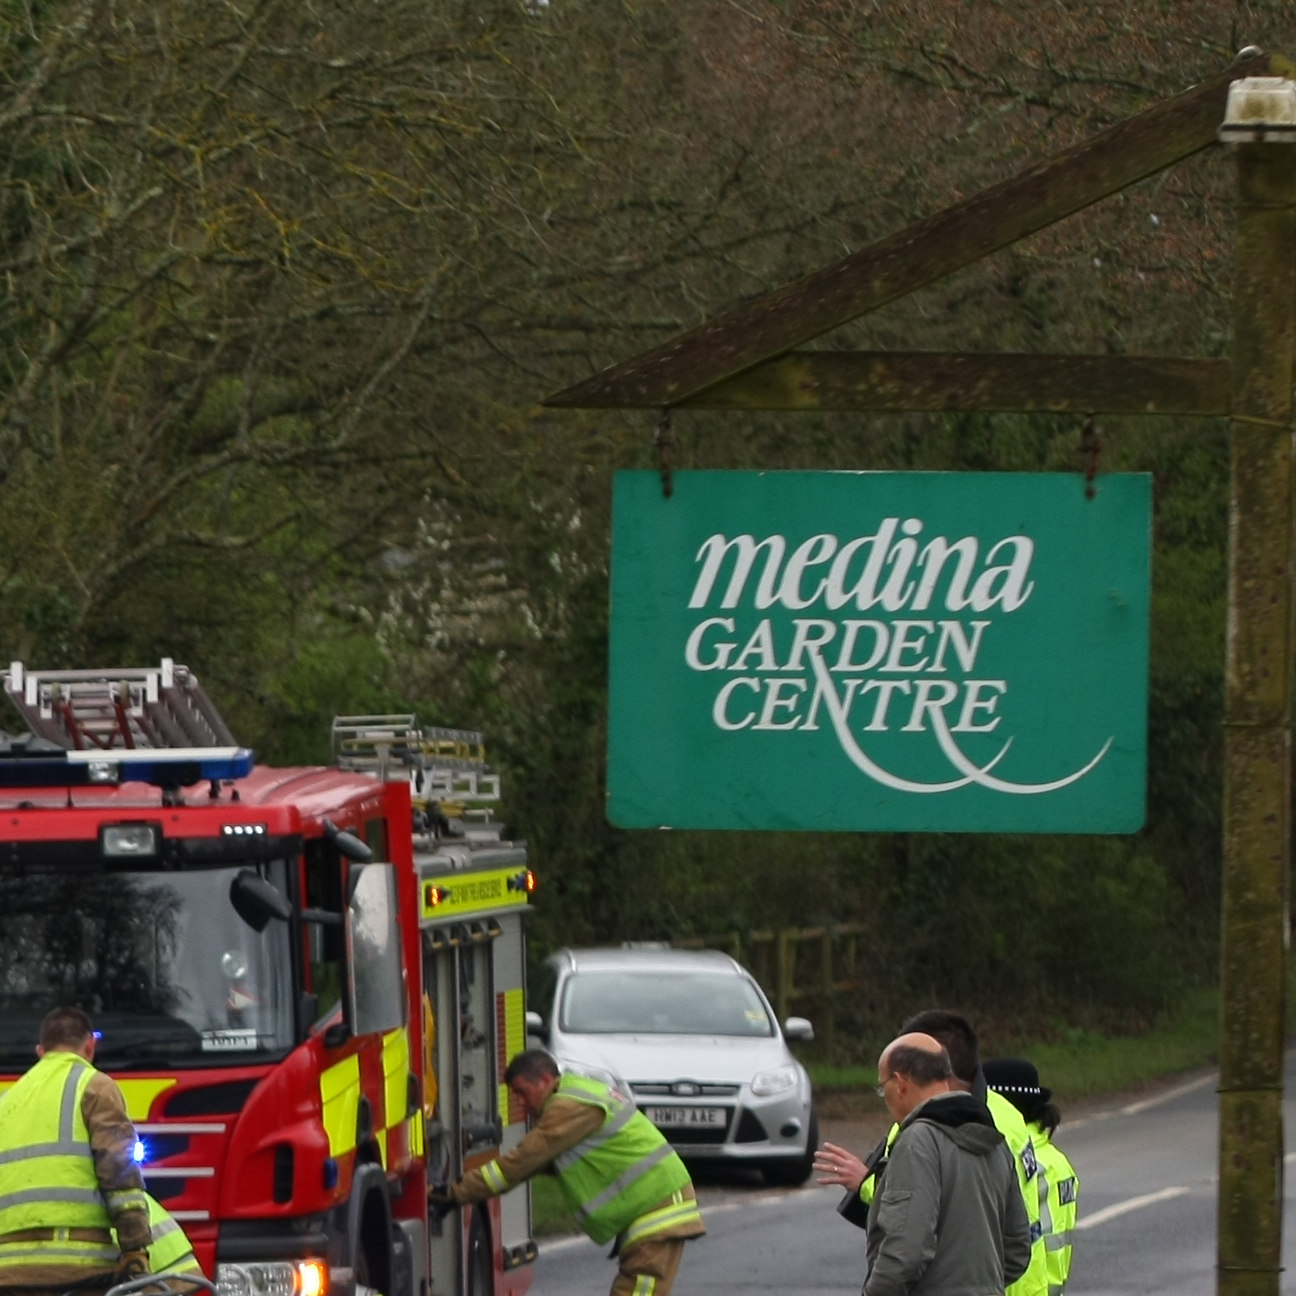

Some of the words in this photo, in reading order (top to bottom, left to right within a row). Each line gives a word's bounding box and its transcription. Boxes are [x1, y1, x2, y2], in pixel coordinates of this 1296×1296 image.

[688, 518, 1034, 613] medina
[684, 617, 991, 673] GARDEN
[712, 677, 1007, 733] CENTRE
